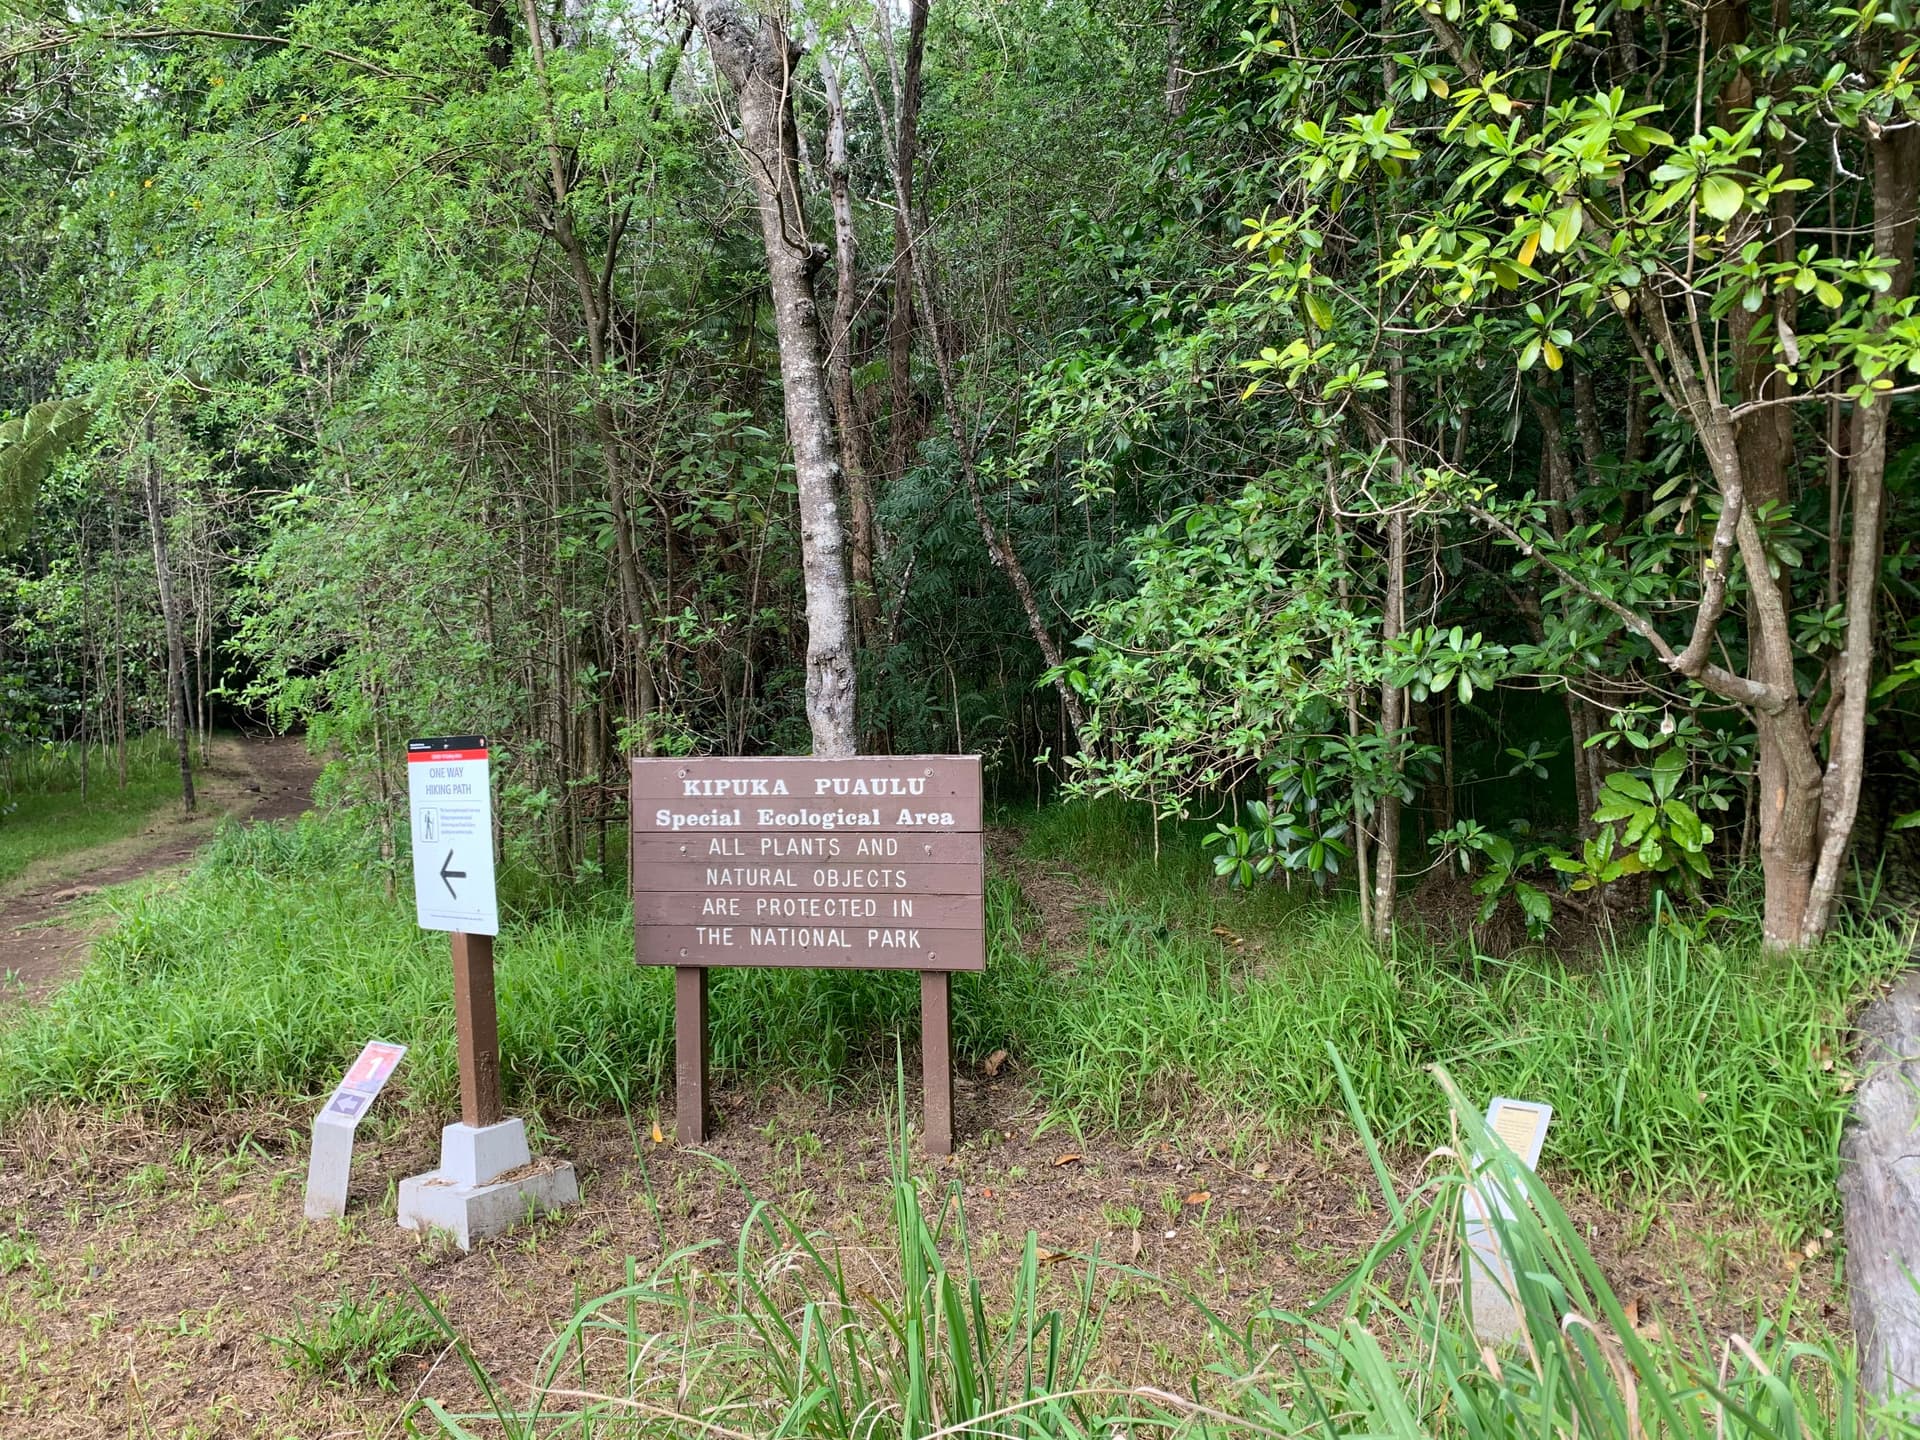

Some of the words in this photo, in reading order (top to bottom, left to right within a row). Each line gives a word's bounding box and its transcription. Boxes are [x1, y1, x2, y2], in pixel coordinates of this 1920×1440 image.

[429, 768, 445, 778] ONE
[447, 767, 464, 778] WAY
[425, 784, 452, 795] HIKING
[453, 783, 472, 795] PATH
[683, 779, 789, 796] KIPUKA
[814, 778, 926, 795] PUAULU
[656, 809, 741, 830] Special
[757, 808, 880, 830] Ecological
[896, 808, 955, 826] Area
[708, 838, 745, 856] ALL
[761, 838, 840, 856] PLANTS
[856, 838, 898, 856] AND
[706, 868, 797, 887] NATURAL
[813, 869, 907, 888] OBJECTS
[702, 898, 740, 916] ARE
[756, 898, 877, 917] PROTECTED
[893, 899, 913, 918] IN
[695, 927, 734, 946] THE
[750, 928, 851, 948] NATIONAL
[868, 929, 921, 949] PARK
[366, 1056, 384, 1079] 1
